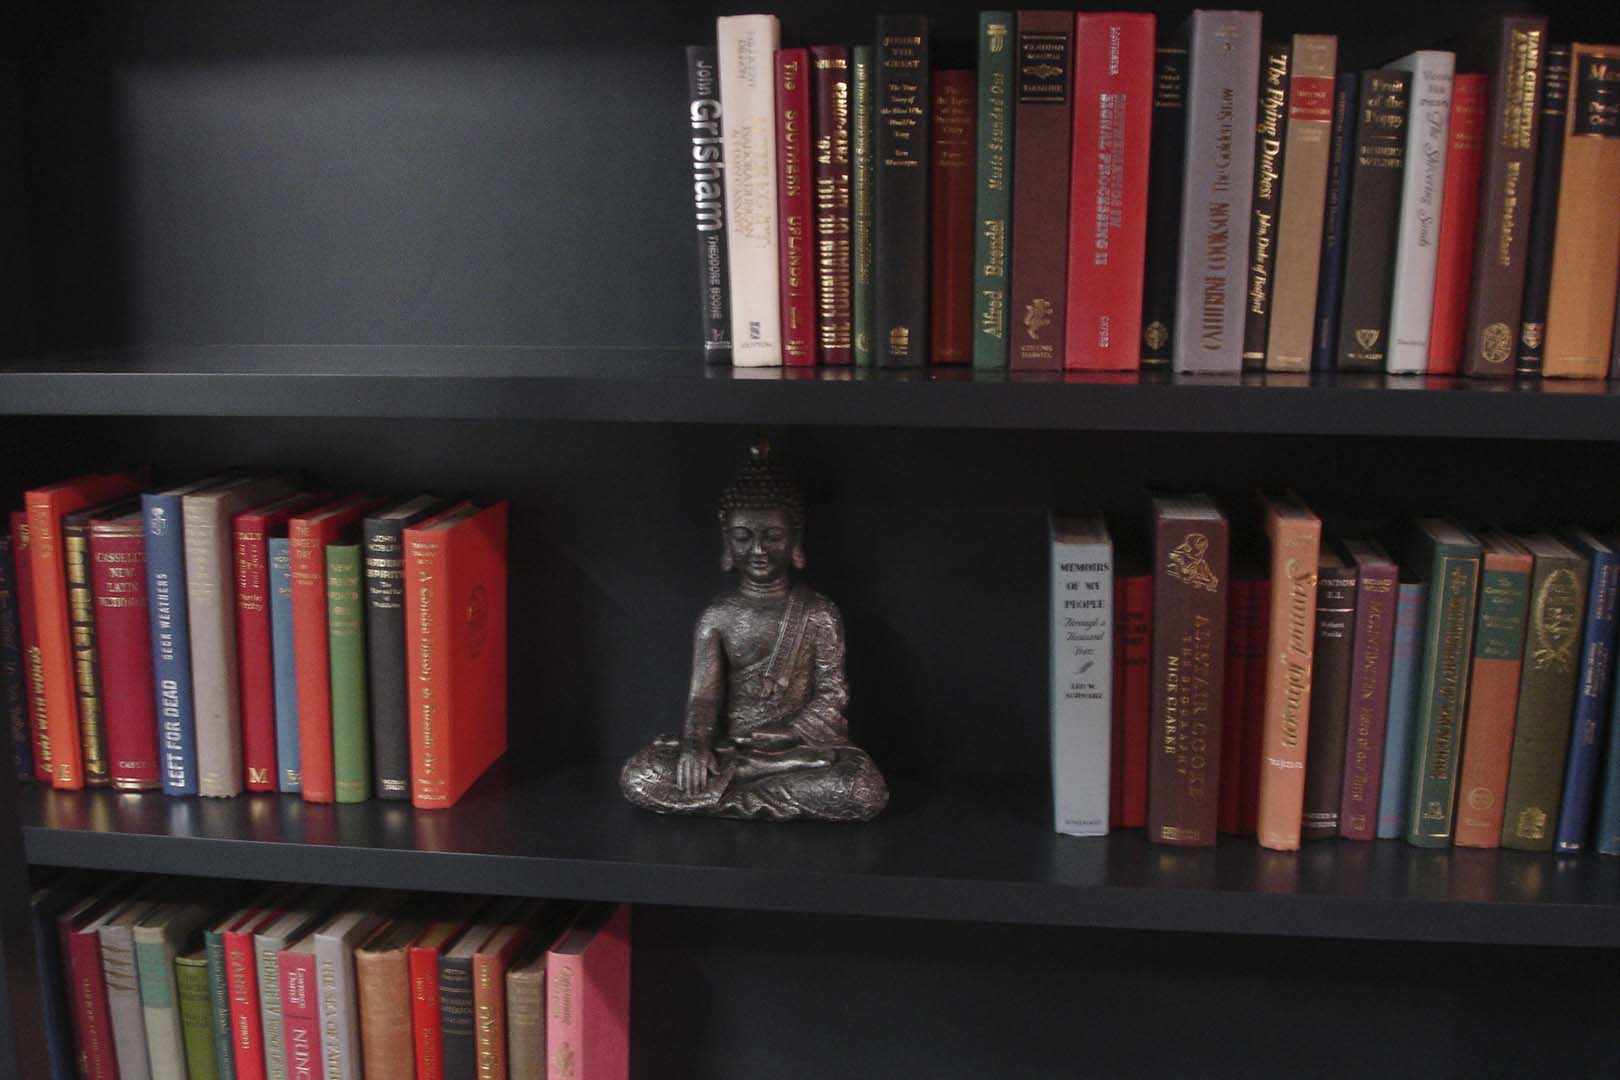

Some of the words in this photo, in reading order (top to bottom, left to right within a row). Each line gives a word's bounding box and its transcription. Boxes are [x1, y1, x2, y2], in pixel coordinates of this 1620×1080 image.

[696, 61, 713, 95] John
[784, 61, 799, 91] The
[1269, 55, 1288, 85] The
[990, 100, 1005, 153] Sounded
[1098, 94, 1114, 150] SIGNAL
[1257, 88, 1285, 138] Flying
[1426, 111, 1442, 137] The
[1518, 71, 1538, 149] CHRISTIAN
[690, 99, 726, 231] Grisham
[784, 110, 801, 198] SOUTHERN
[1214, 124, 1232, 170] Golden
[1257, 139, 1280, 200] Duchess
[988, 159, 1004, 190] Music
[1212, 176, 1229, 192] The
[1420, 143, 1442, 206] Shivering
[1096, 153, 1112, 249] PROCESSING
[788, 216, 803, 287] UPLANDS
[986, 220, 1005, 276] Brendel
[1205, 202, 1231, 270] COOKSON
[1417, 209, 1434, 248] Sands
[708, 236, 722, 284] THEODORE
[710, 287, 723, 319] BOONE
[983, 290, 1004, 338] Alfred
[1200, 275, 1230, 350] CATHERINE
[1060, 563, 1109, 572] MEMOIRS
[1066, 582, 1079, 590] OF
[1085, 582, 1100, 590] MY
[155, 573, 172, 629] WEATHERS
[1065, 600, 1104, 608] PEOPLE
[1286, 559, 1318, 657] Samuel
[160, 633, 175, 661] BECK
[1191, 615, 1214, 716] ALISTAIR
[1167, 656, 1179, 692] NICK
[160, 680, 180, 718] DEAD
[1281, 654, 1312, 748] Johnson
[164, 721, 183, 751] FOR
[1164, 696, 1179, 755] CLARKE
[166, 754, 186, 787] LEFT
[1187, 723, 1208, 800] COOKE
[288, 971, 299, 1004] Durrell
[296, 968, 307, 1009] Lawrence
